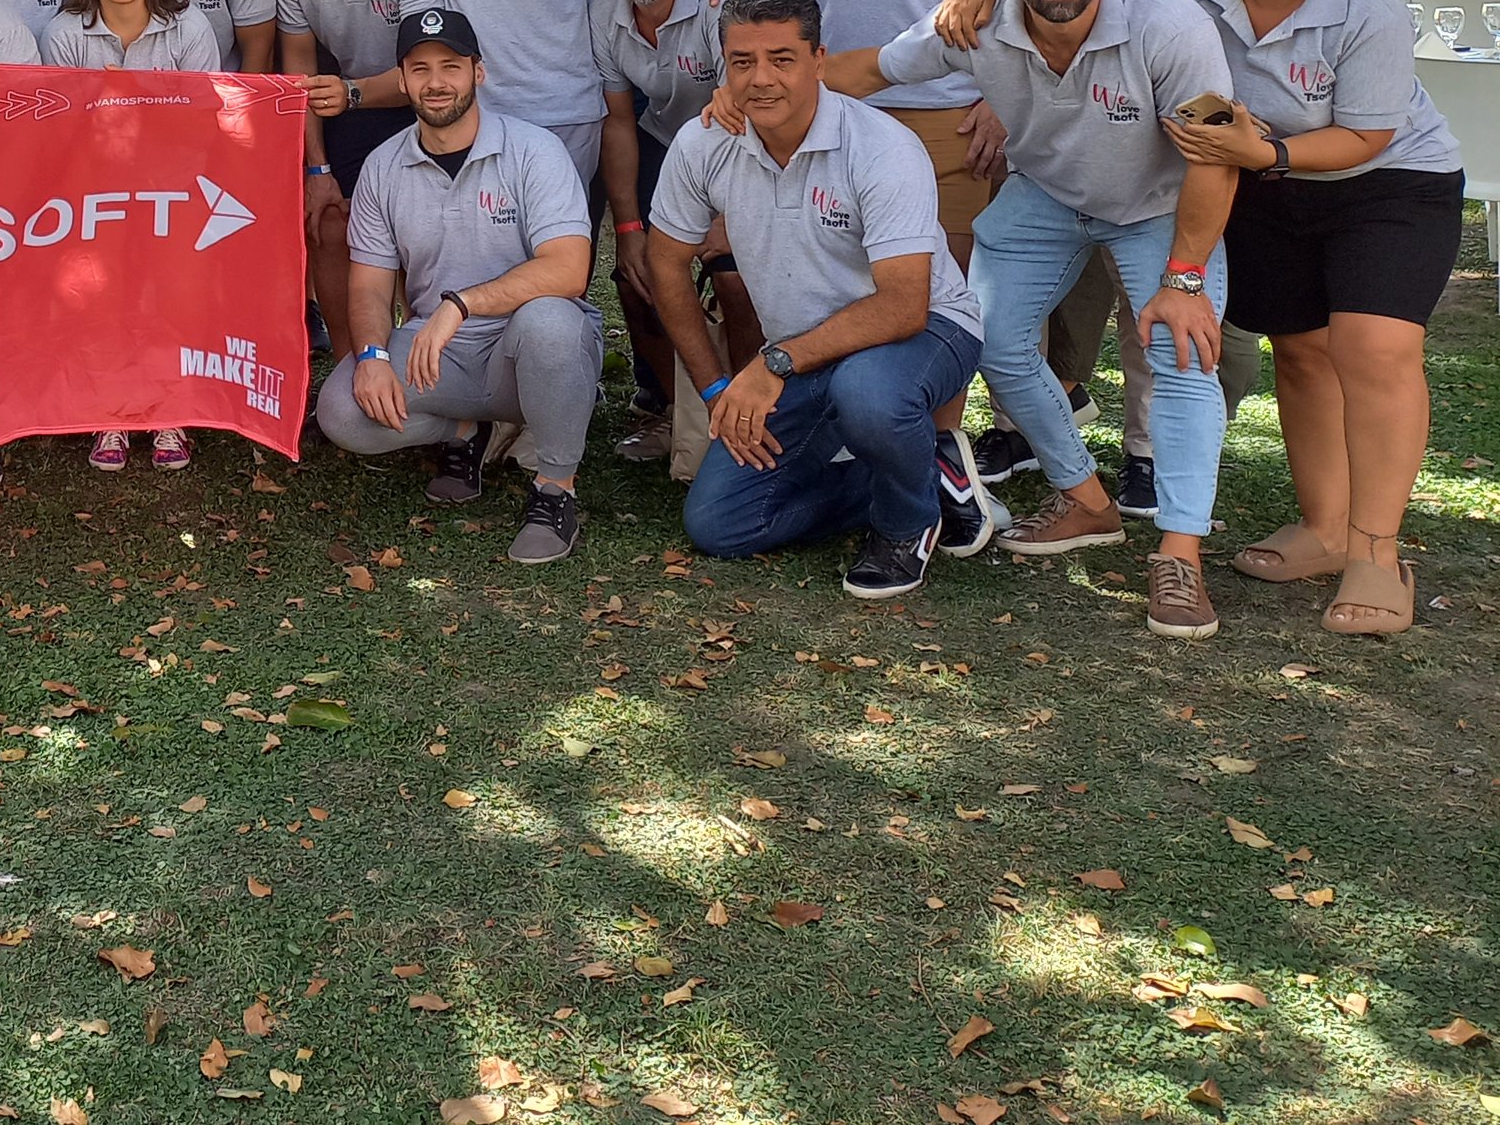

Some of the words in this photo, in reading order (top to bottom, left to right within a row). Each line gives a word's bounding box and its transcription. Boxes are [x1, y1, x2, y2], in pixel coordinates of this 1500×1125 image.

[1289, 60, 1332, 92] We
[85, 95, 190, 110] #VAMOSPORMÁS
[1093, 81, 1130, 111] We
[1106, 112, 1140, 122] Tsoft
[1117, 104, 1140, 114] love
[480, 186, 508, 215] We
[812, 186, 841, 215] We
[490, 216, 517, 225] Tsoft
[498, 207, 517, 216] love
[830, 209, 850, 220] love
[820, 216, 850, 229] Tsoft
[225, 335, 257, 362] WE
[180, 346, 256, 390] MAKE
[258, 364, 284, 400] IT
[246, 388, 281, 420] REAL
